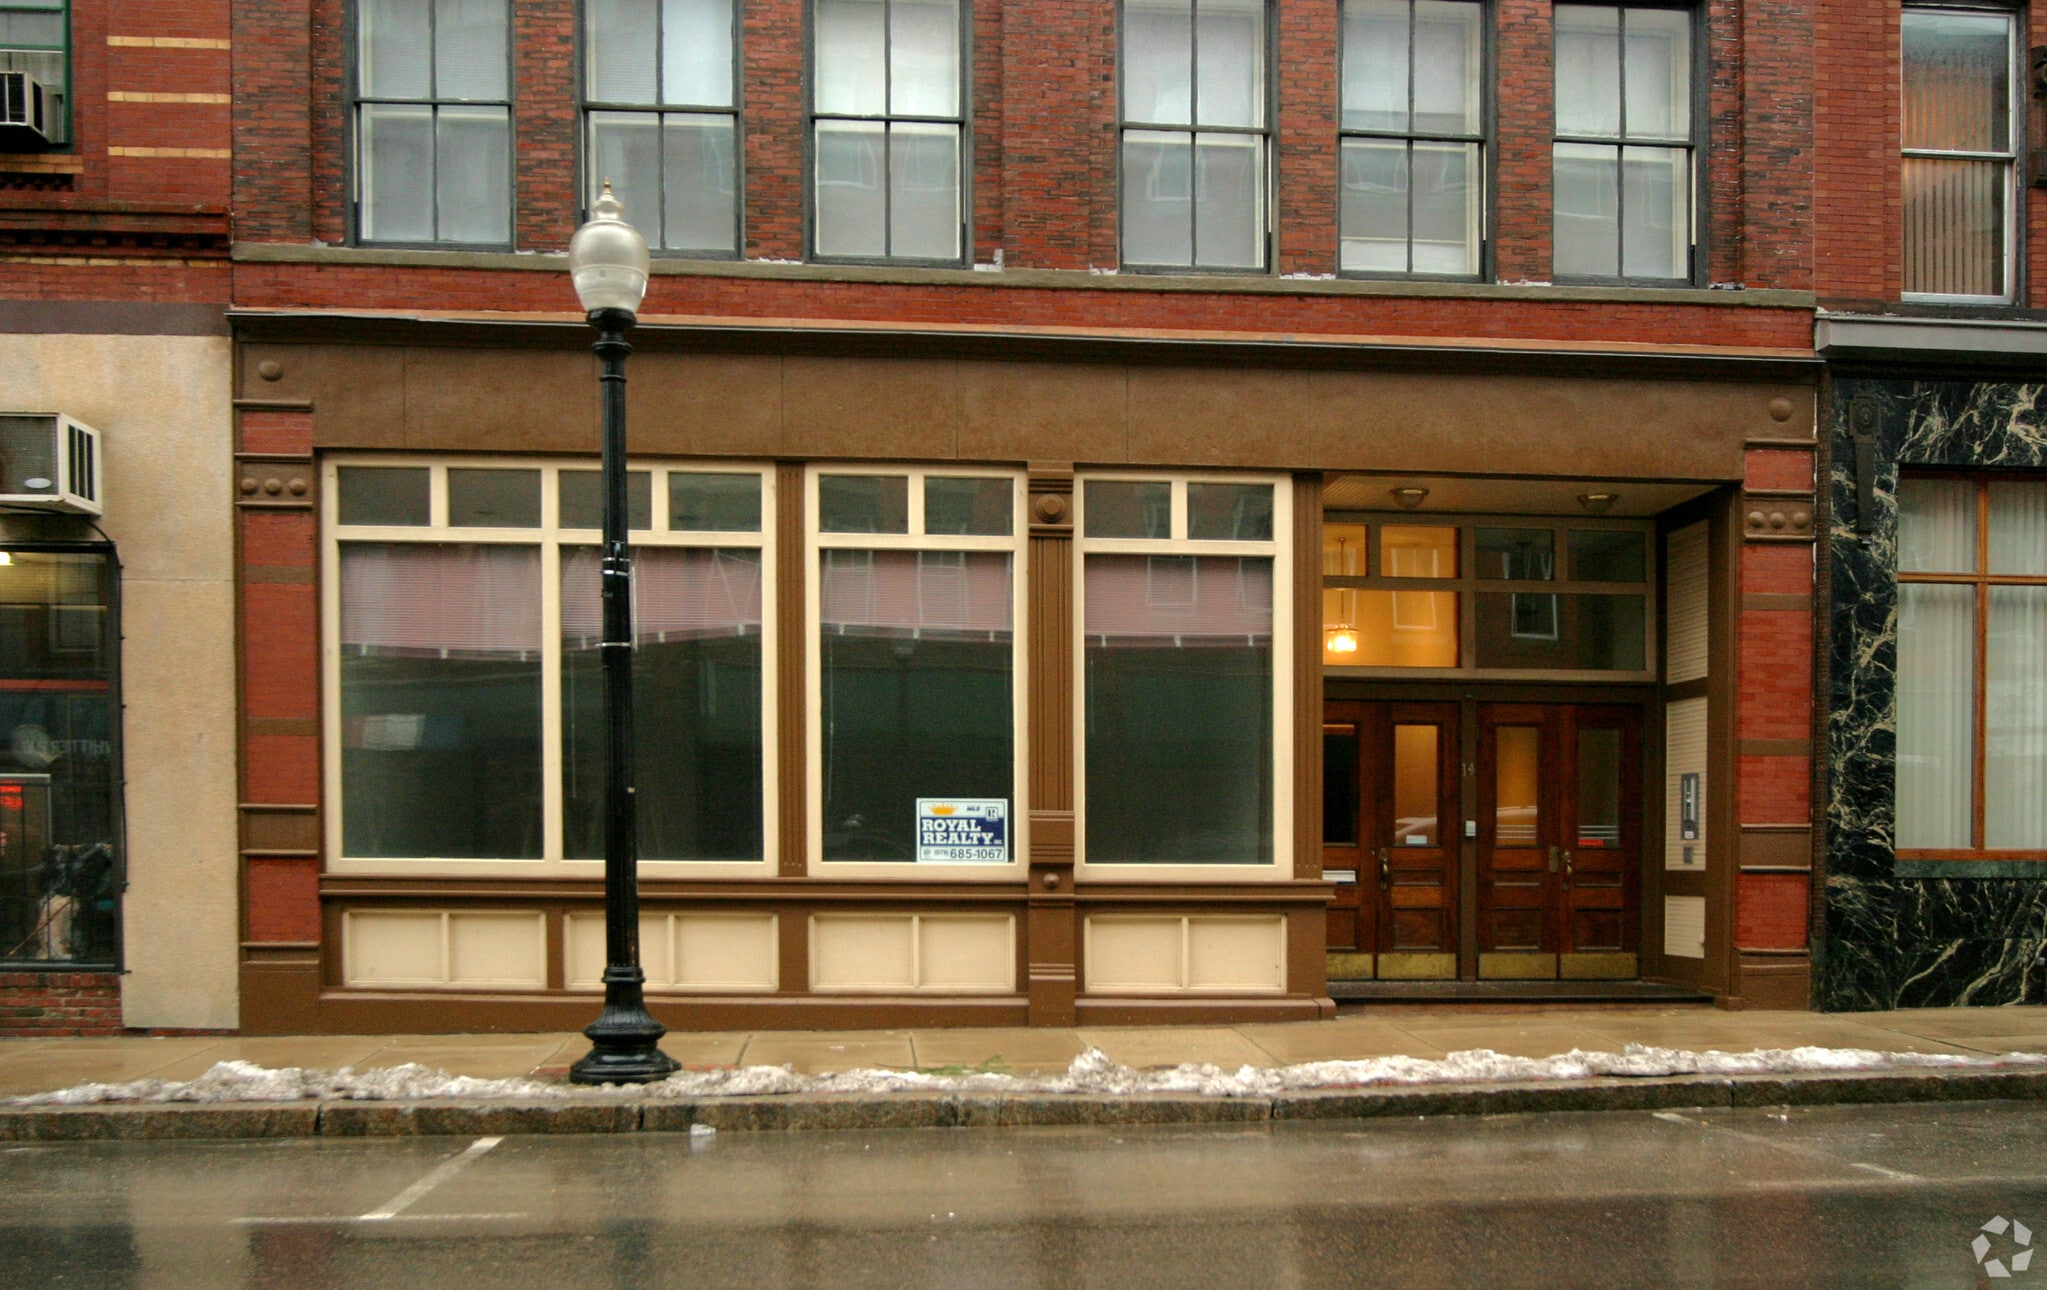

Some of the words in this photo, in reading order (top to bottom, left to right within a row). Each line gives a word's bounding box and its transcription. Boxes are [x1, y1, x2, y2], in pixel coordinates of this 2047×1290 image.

[921, 819, 982, 832] ROYAL
[922, 832, 994, 845] REALTY
[950, 848, 1003, 859] 685-1067
